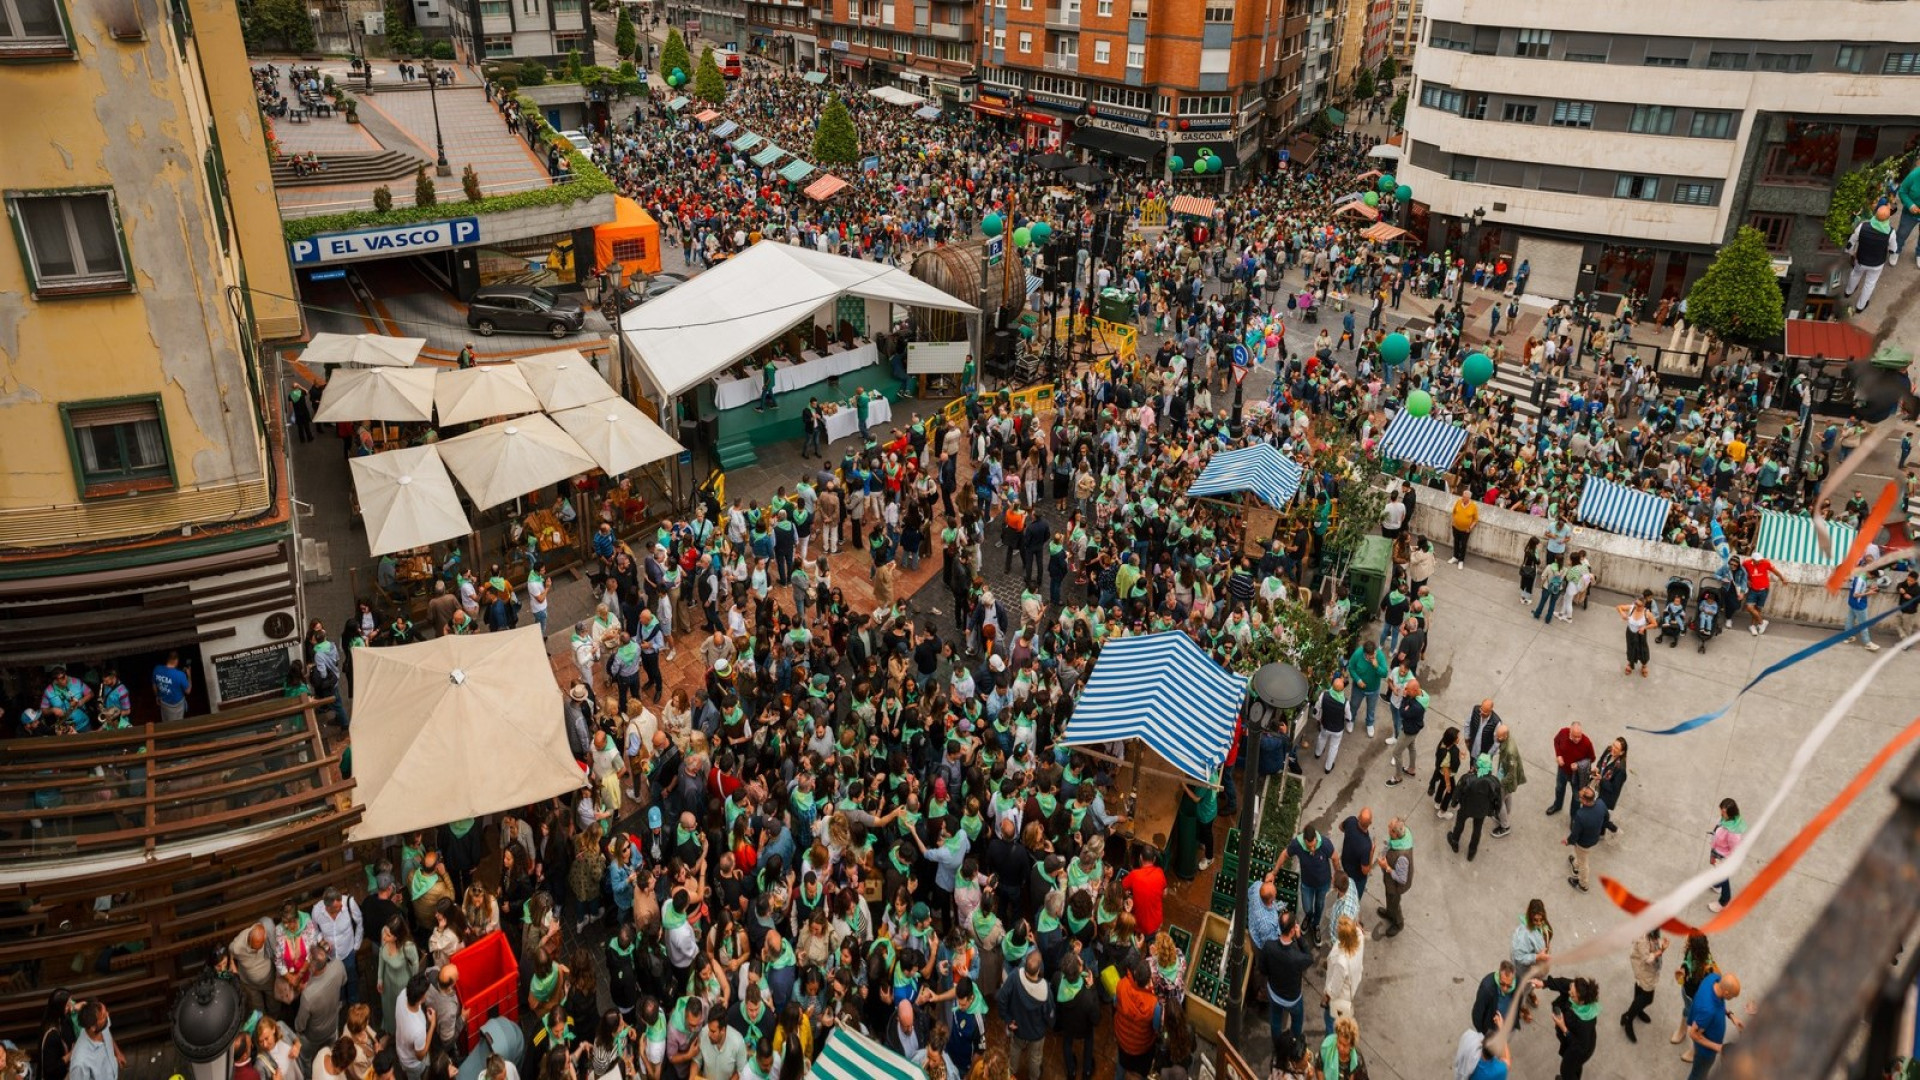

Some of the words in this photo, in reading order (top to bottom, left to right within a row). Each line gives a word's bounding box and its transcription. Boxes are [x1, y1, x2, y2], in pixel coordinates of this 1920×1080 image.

[1100, 120, 1110, 129] LA
[1110, 121, 1140, 135] CANTINA
[1150, 130, 1161, 139] DE
[1180, 132, 1224, 141] GASCONA
[293, 240, 313, 262] P
[331, 239, 358, 254] EL
[364, 229, 440, 250] VASCO
[455, 221, 474, 242] P
